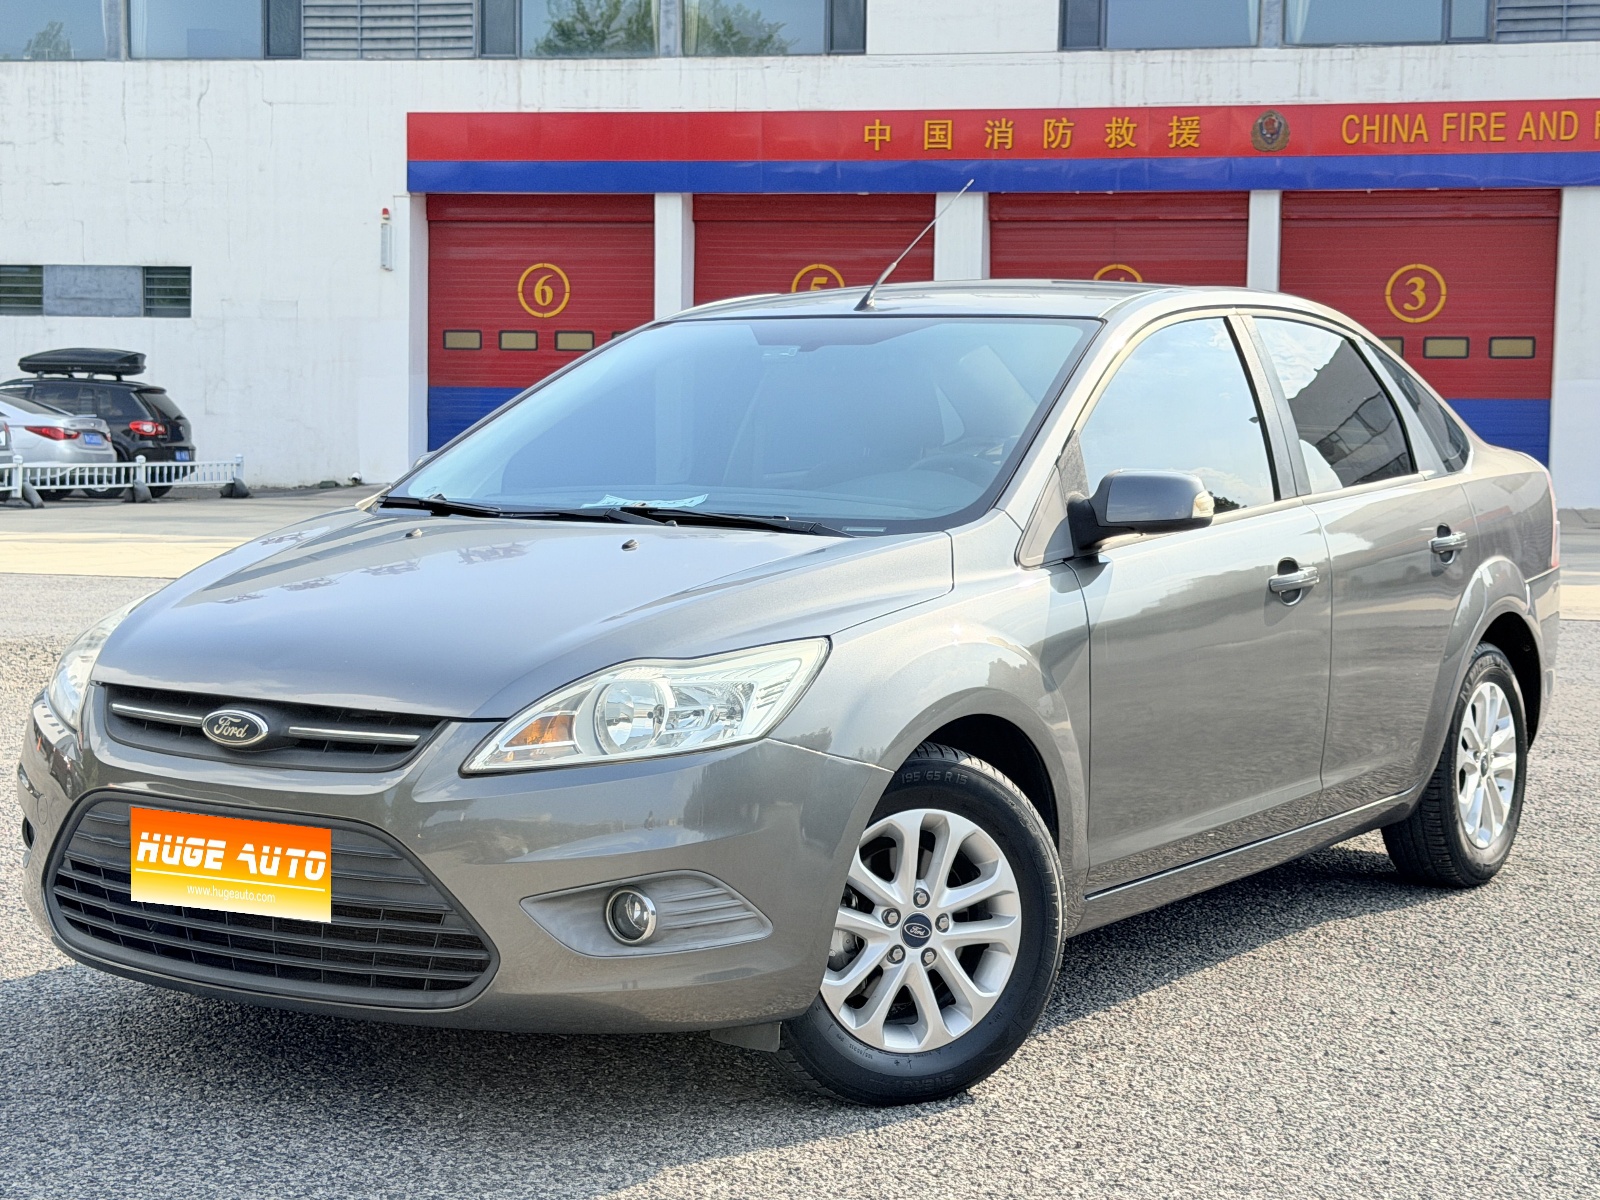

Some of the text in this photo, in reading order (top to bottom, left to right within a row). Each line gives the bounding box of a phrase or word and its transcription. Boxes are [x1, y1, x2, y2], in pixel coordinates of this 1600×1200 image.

[863, 115, 1201, 151] 中国消防救援
[1341, 113, 1429, 144] CHINA
[1441, 111, 1507, 142] FIRE
[1517, 110, 1580, 141] AND
[534, 274, 554, 307] 6
[1403, 276, 1427, 311] 3
[213, 716, 249, 738] Ford
[909, 925, 926, 936] Ford
